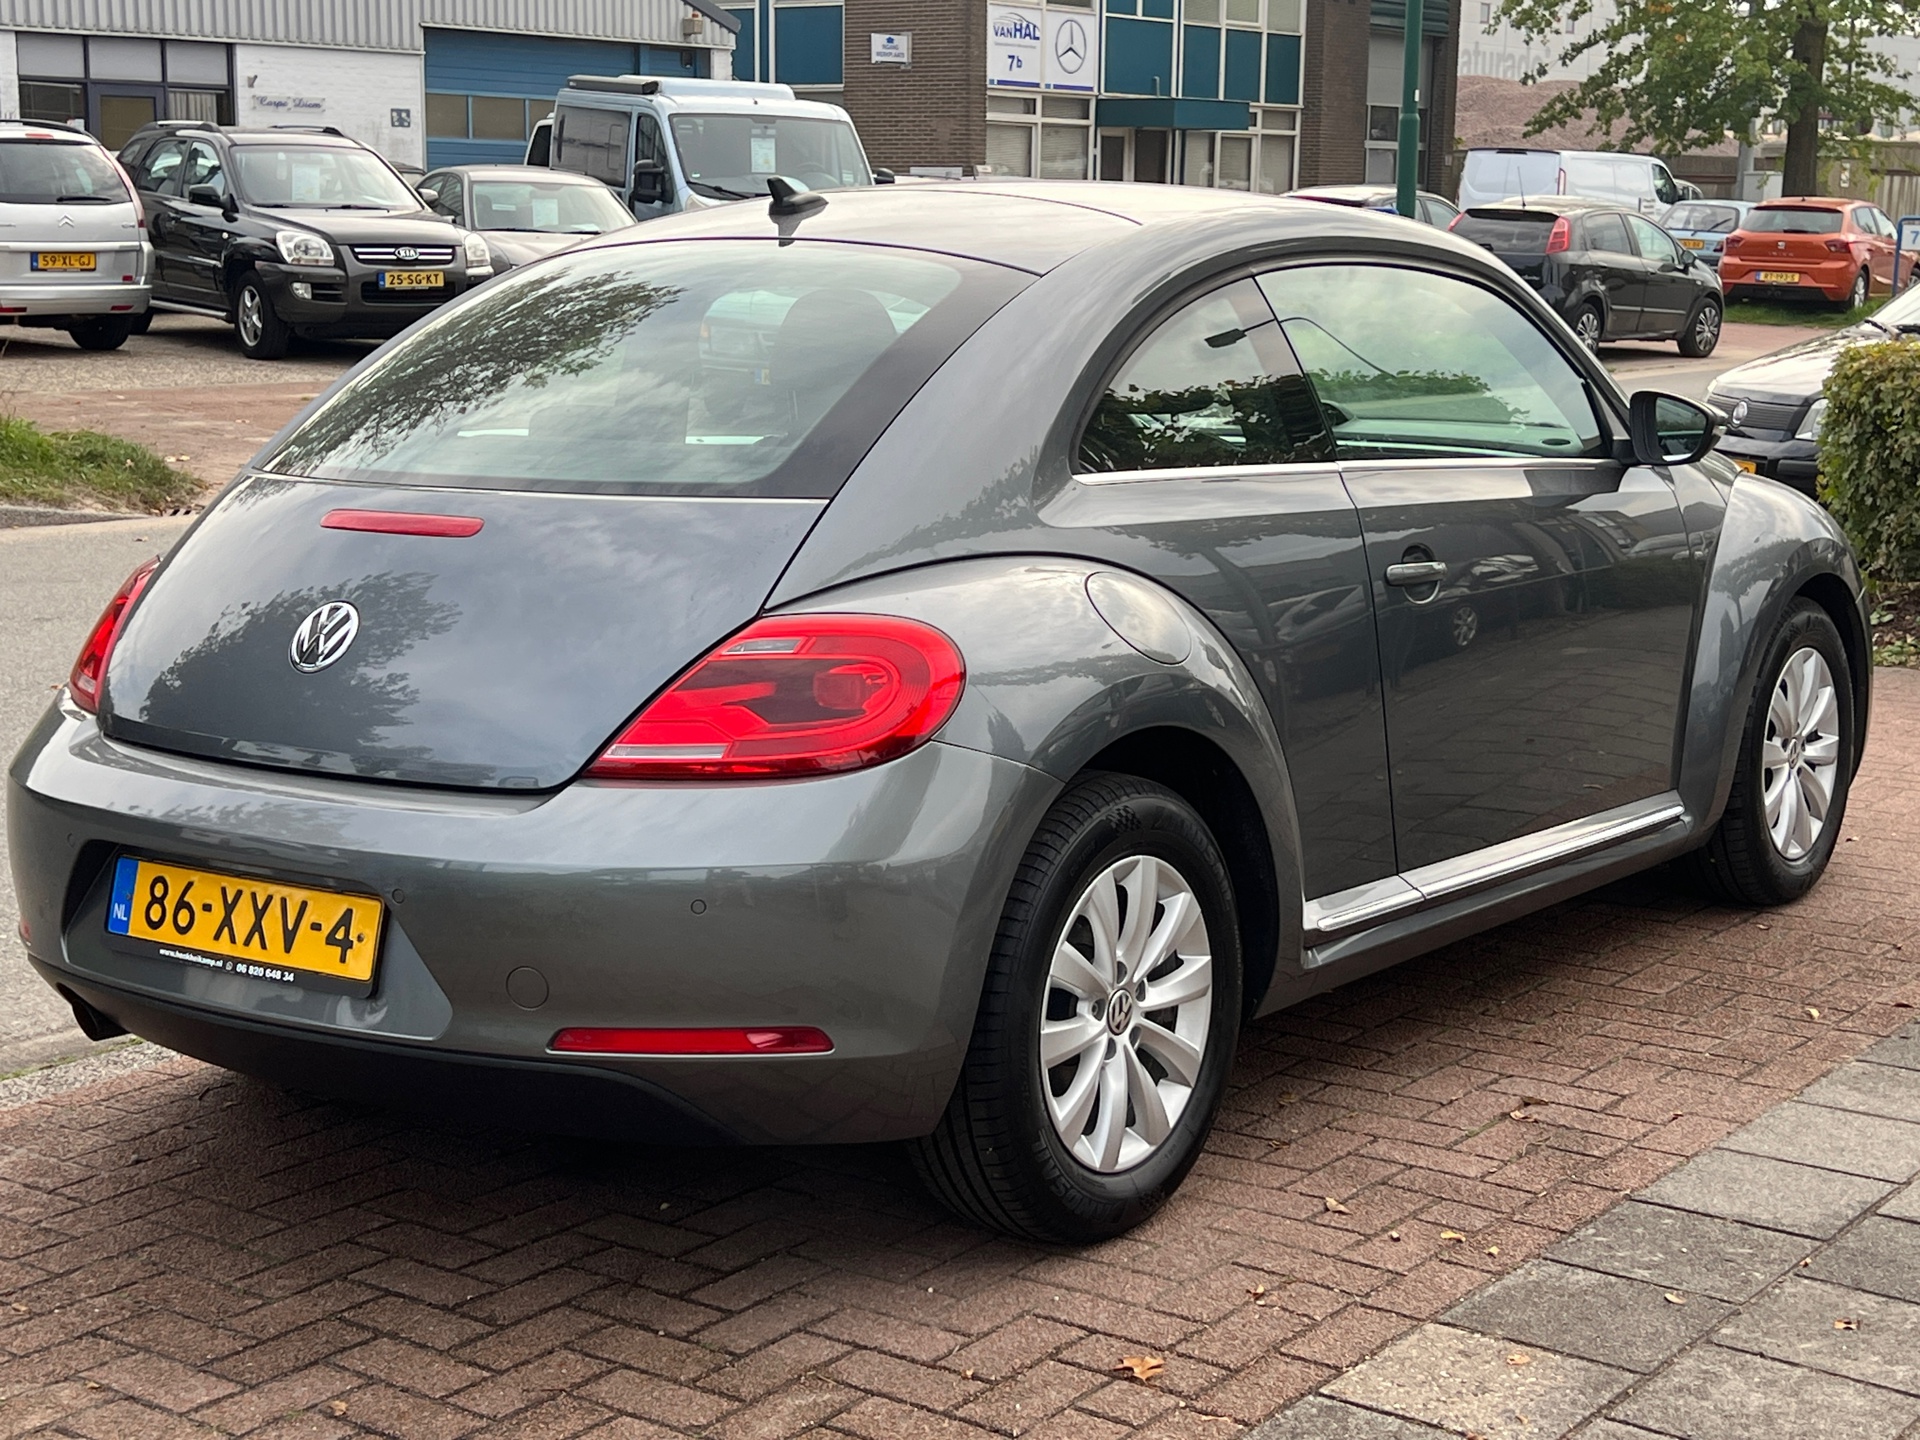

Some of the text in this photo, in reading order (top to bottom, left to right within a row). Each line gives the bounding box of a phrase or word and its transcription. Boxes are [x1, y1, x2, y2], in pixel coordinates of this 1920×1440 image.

[1007, 54, 1023, 71] 7b
[42, 254, 91, 267] 59-XL-GJ
[389, 274, 440, 285] 25-SG-KT
[113, 902, 128, 921] NL
[144, 875, 355, 964] 86-XXV-4
[236, 963, 247, 974] 06
[248, 965, 264, 976] 820
[265, 968, 281, 980] 648
[282, 971, 295, 982] 34
